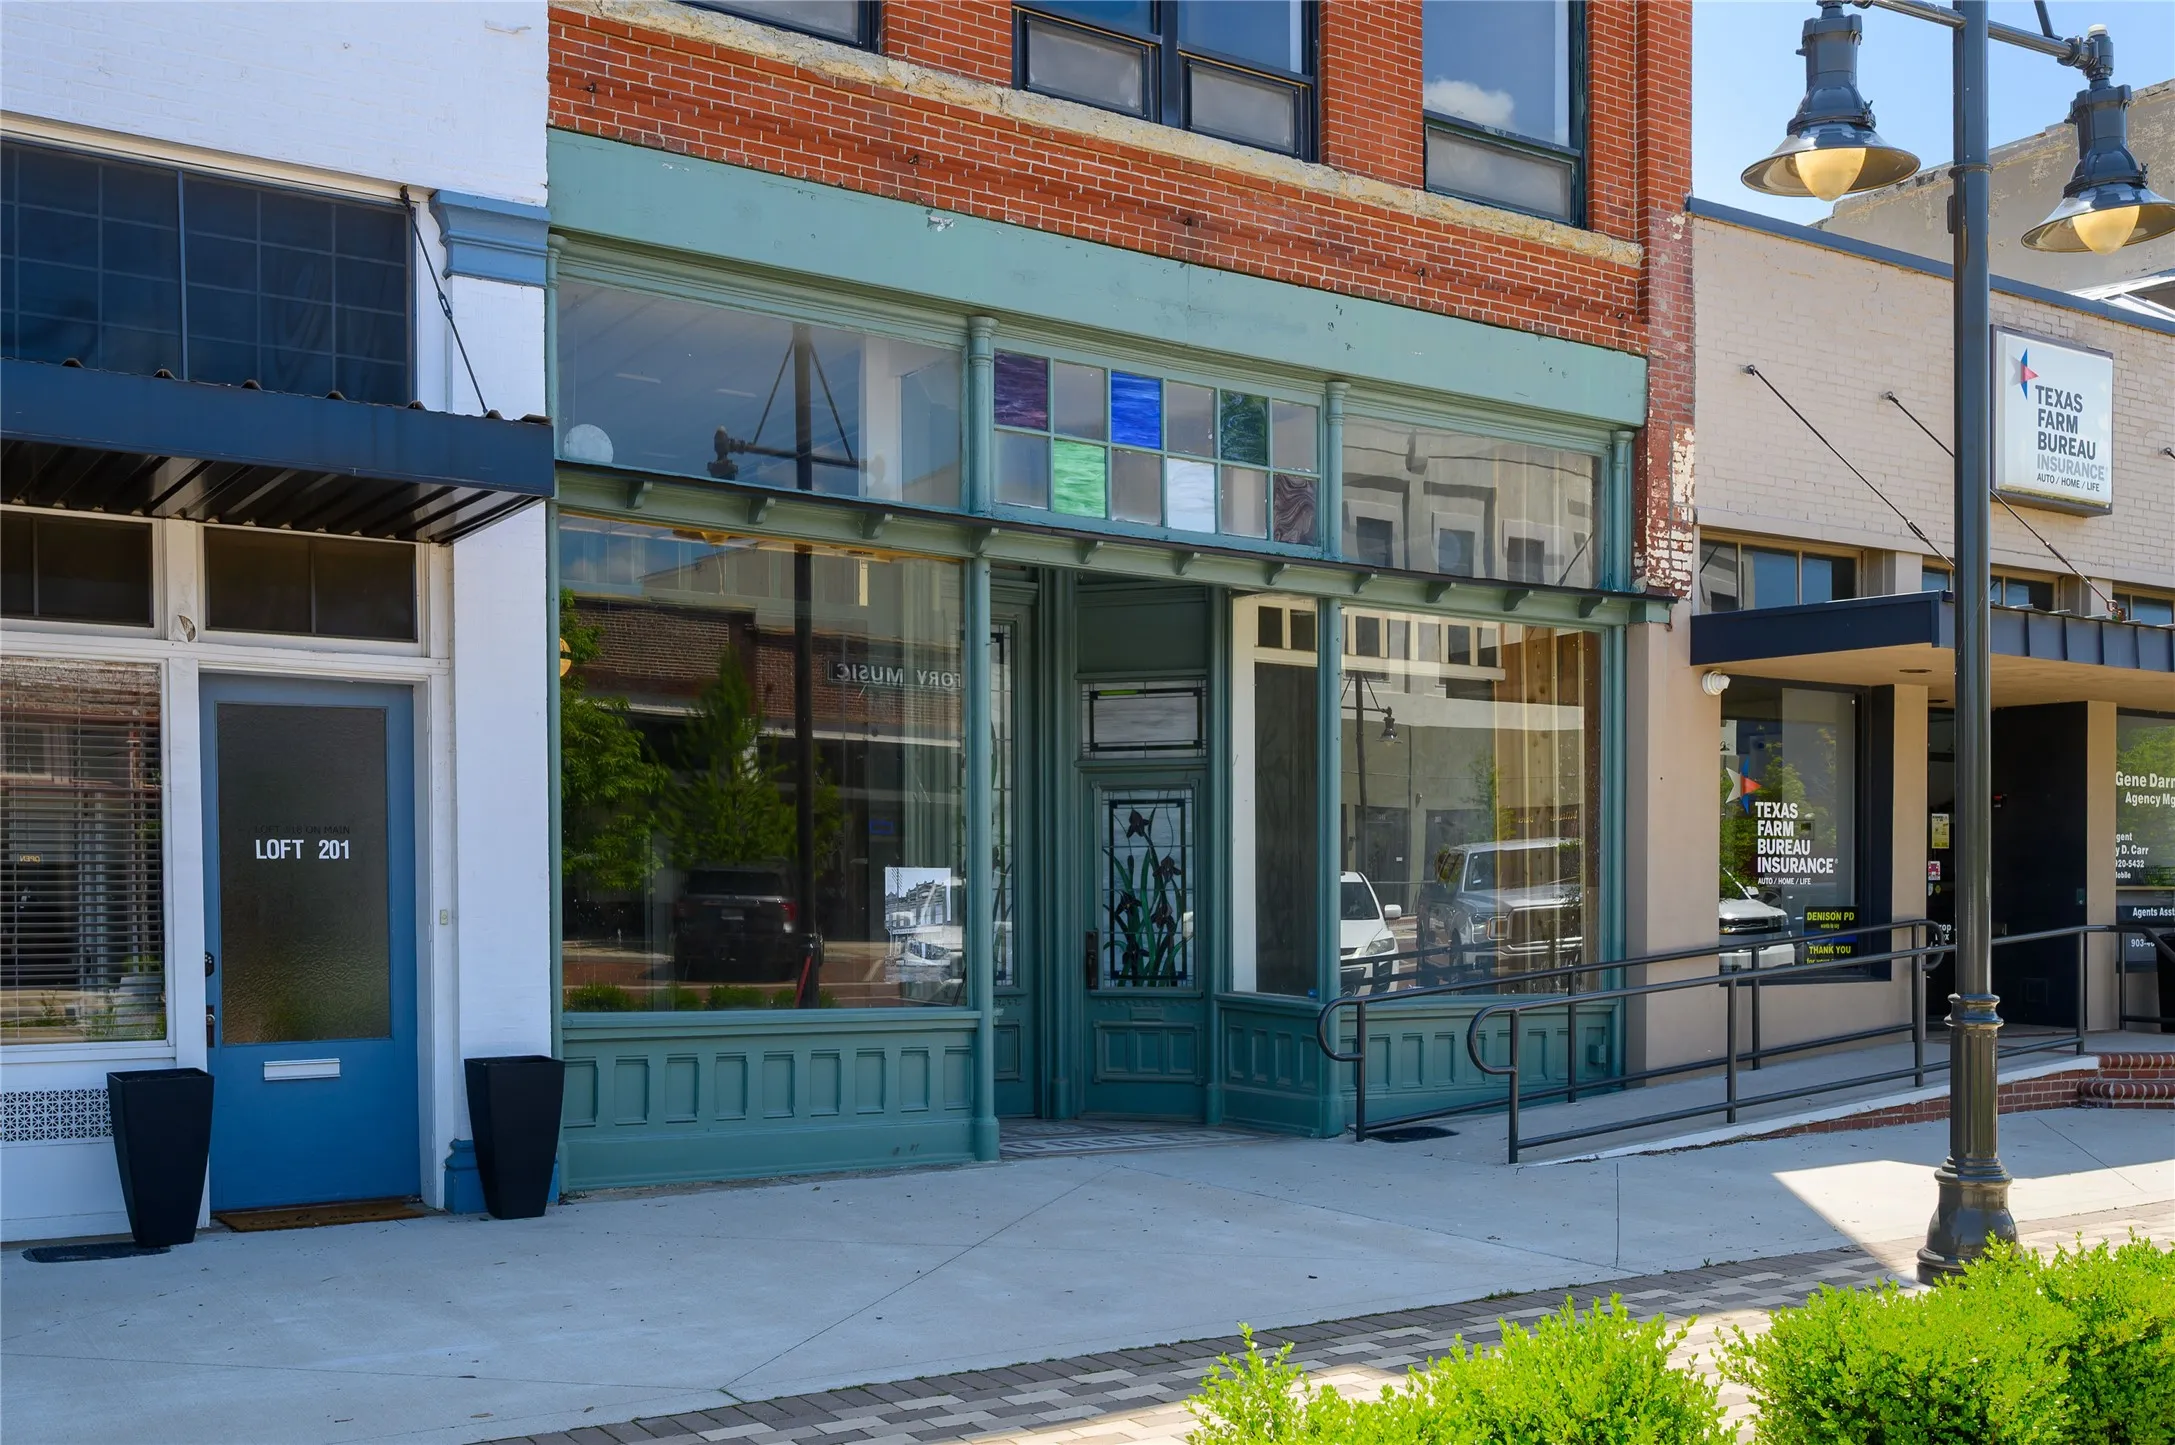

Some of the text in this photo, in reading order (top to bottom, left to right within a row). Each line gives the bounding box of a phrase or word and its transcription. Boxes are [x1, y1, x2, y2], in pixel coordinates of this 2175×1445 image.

[2035, 384, 2083, 413] TEXAS
[2038, 408, 2078, 434] FARM
[2038, 430, 2096, 460] BUREAU
[2037, 473, 2055, 484] AUTO
[2061, 477, 2080, 488] HOME
[2087, 482, 2100, 492] LIFE
[2116, 771, 2147, 787] Gene
[2125, 792, 2160, 808] Agency
[1755, 801, 1799, 819] TEXAS
[1757, 820, 1794, 837] FARM
[255, 839, 350, 859] LOFT 201
[1757, 838, 1811, 855] BUREAU
[2121, 844, 2130, 855] D.
[2130, 844, 2149, 855] Carr
[1758, 877, 1774, 885] AUTO
[1778, 877, 1795, 885] HOME
[1800, 877, 1812, 885] LIFE
[1806, 911, 1855, 921] DENISON PD
[2132, 907, 2158, 919] Agents
[1809, 945, 1852, 955] THANK YOU
